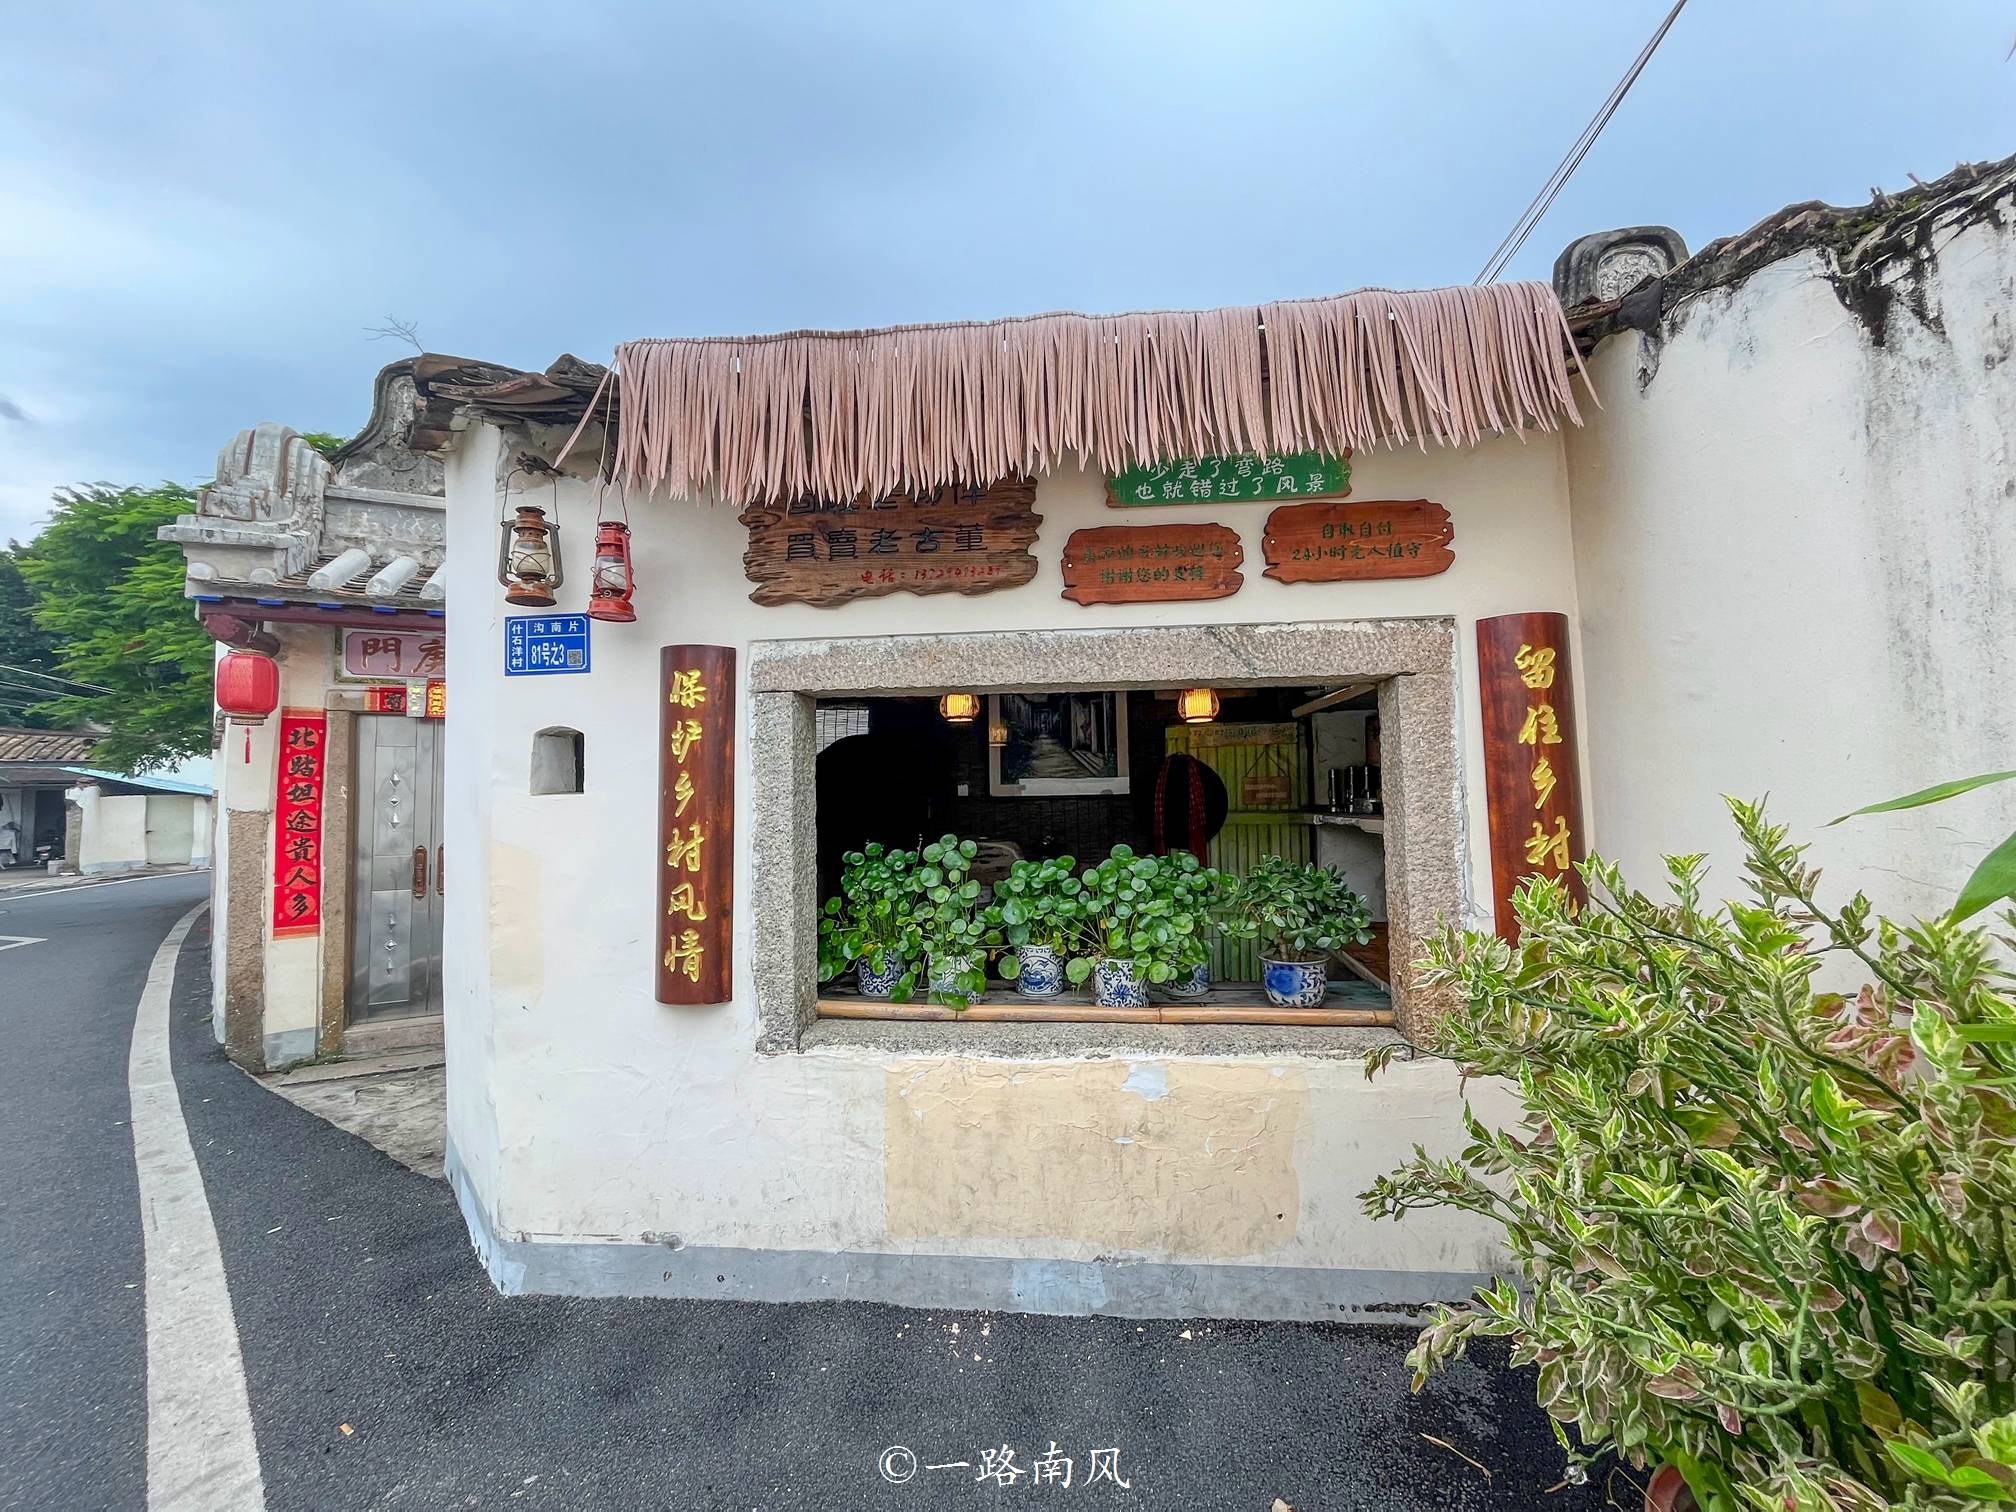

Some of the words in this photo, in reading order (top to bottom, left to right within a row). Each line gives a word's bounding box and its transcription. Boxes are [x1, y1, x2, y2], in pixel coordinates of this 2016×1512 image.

[1150, 458, 1285, 482] 少走了弯路
[1135, 473, 1326, 501] 也就错过了风景
[1321, 520, 1393, 539] 自取自付
[1291, 542, 1423, 561] 24小时无人值守
[533, 620, 580, 634] 沟南片
[511, 624, 524, 668] 什石洋村
[531, 642, 565, 667] 81号之3
[1514, 643, 1578, 918] 留住乡村
[664, 669, 707, 984] 保护乡村风情
